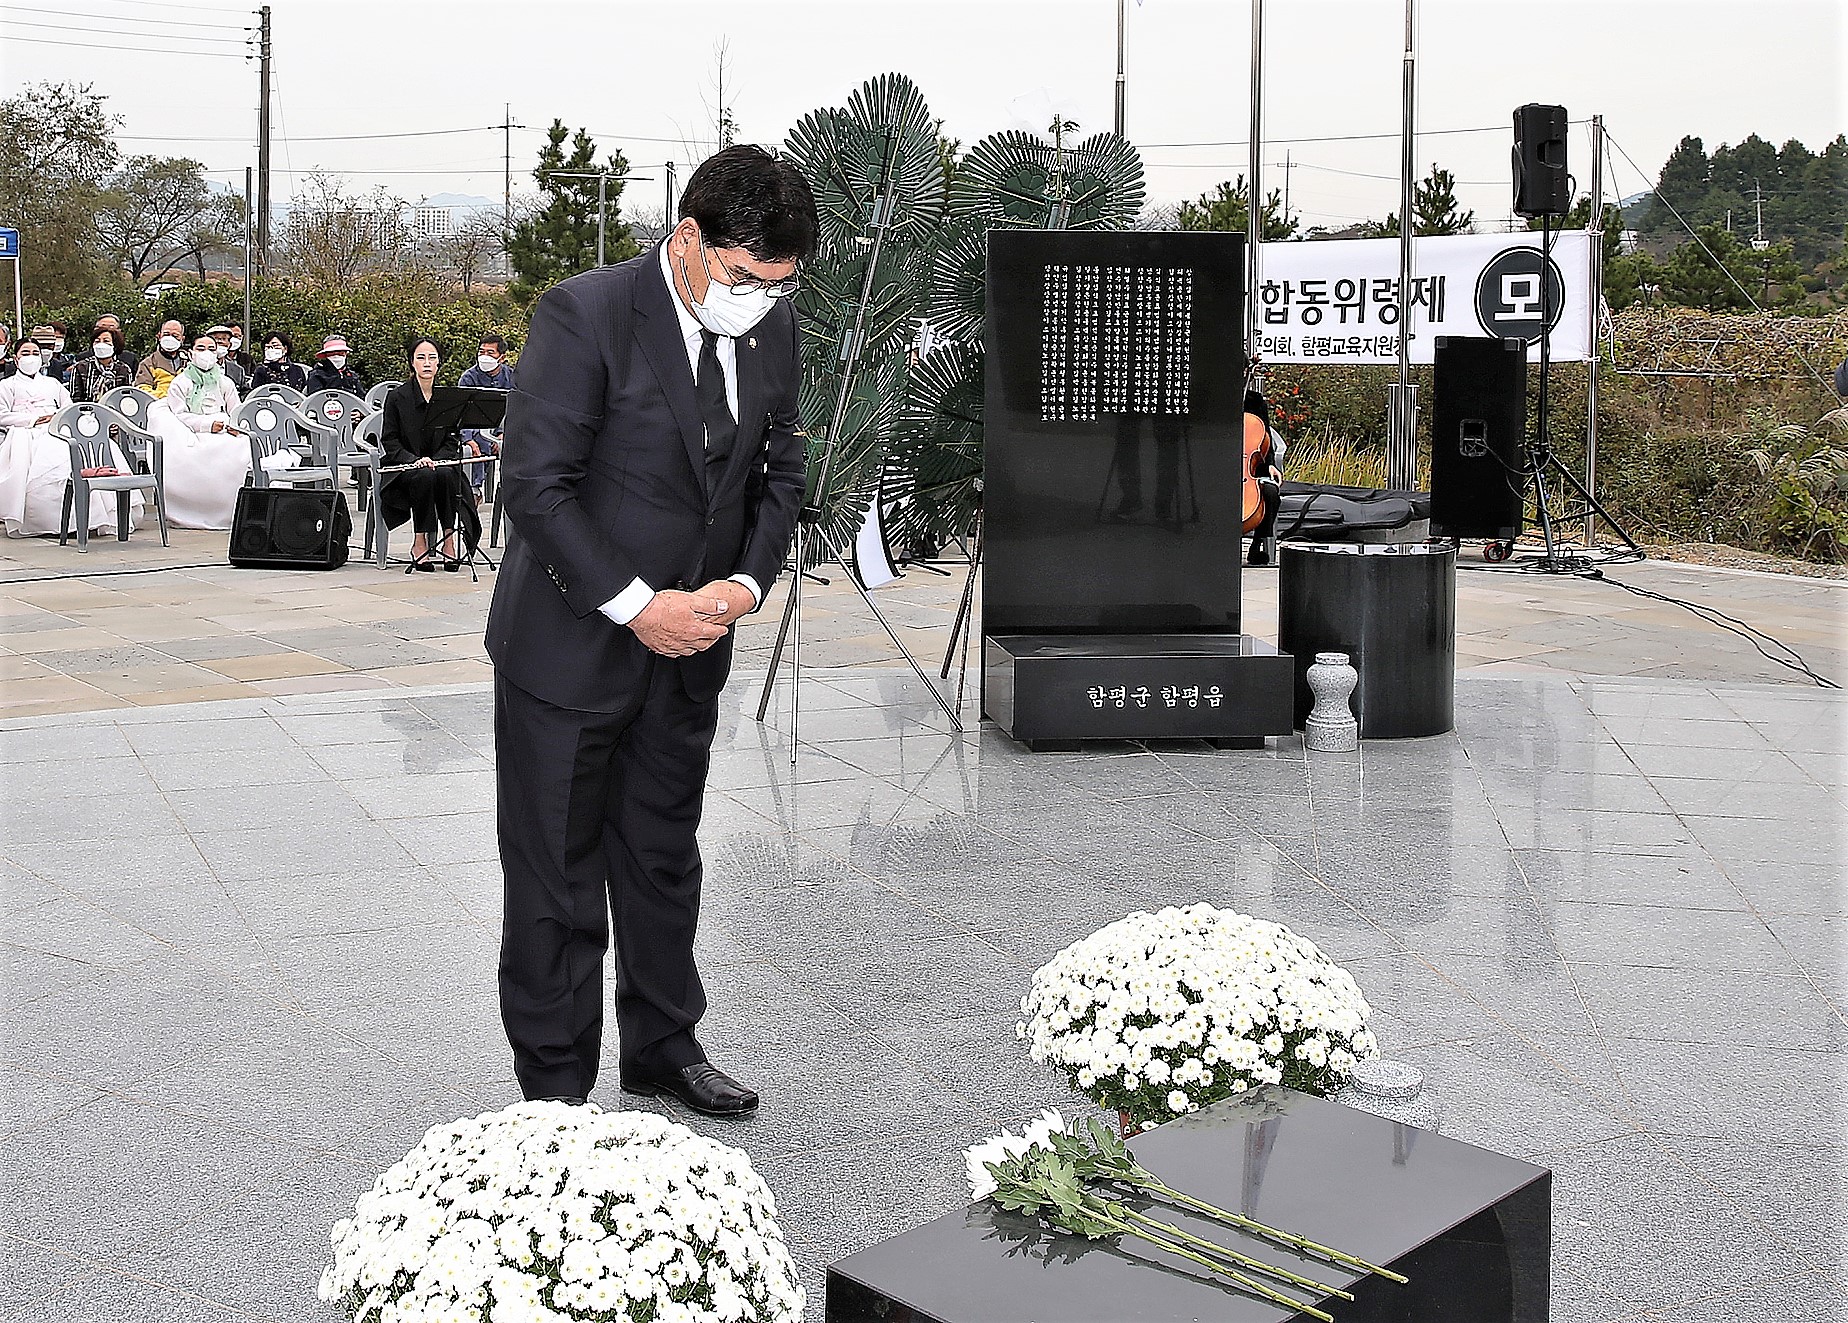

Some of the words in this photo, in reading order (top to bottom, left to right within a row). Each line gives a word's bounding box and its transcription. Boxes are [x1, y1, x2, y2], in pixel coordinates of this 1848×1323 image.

[1260, 276, 1445, 325] 합동위령제
[1494, 273, 1543, 321] 모
[1087, 685, 1152, 709] 함평군
[1159, 684, 1225, 709] 함평읍
